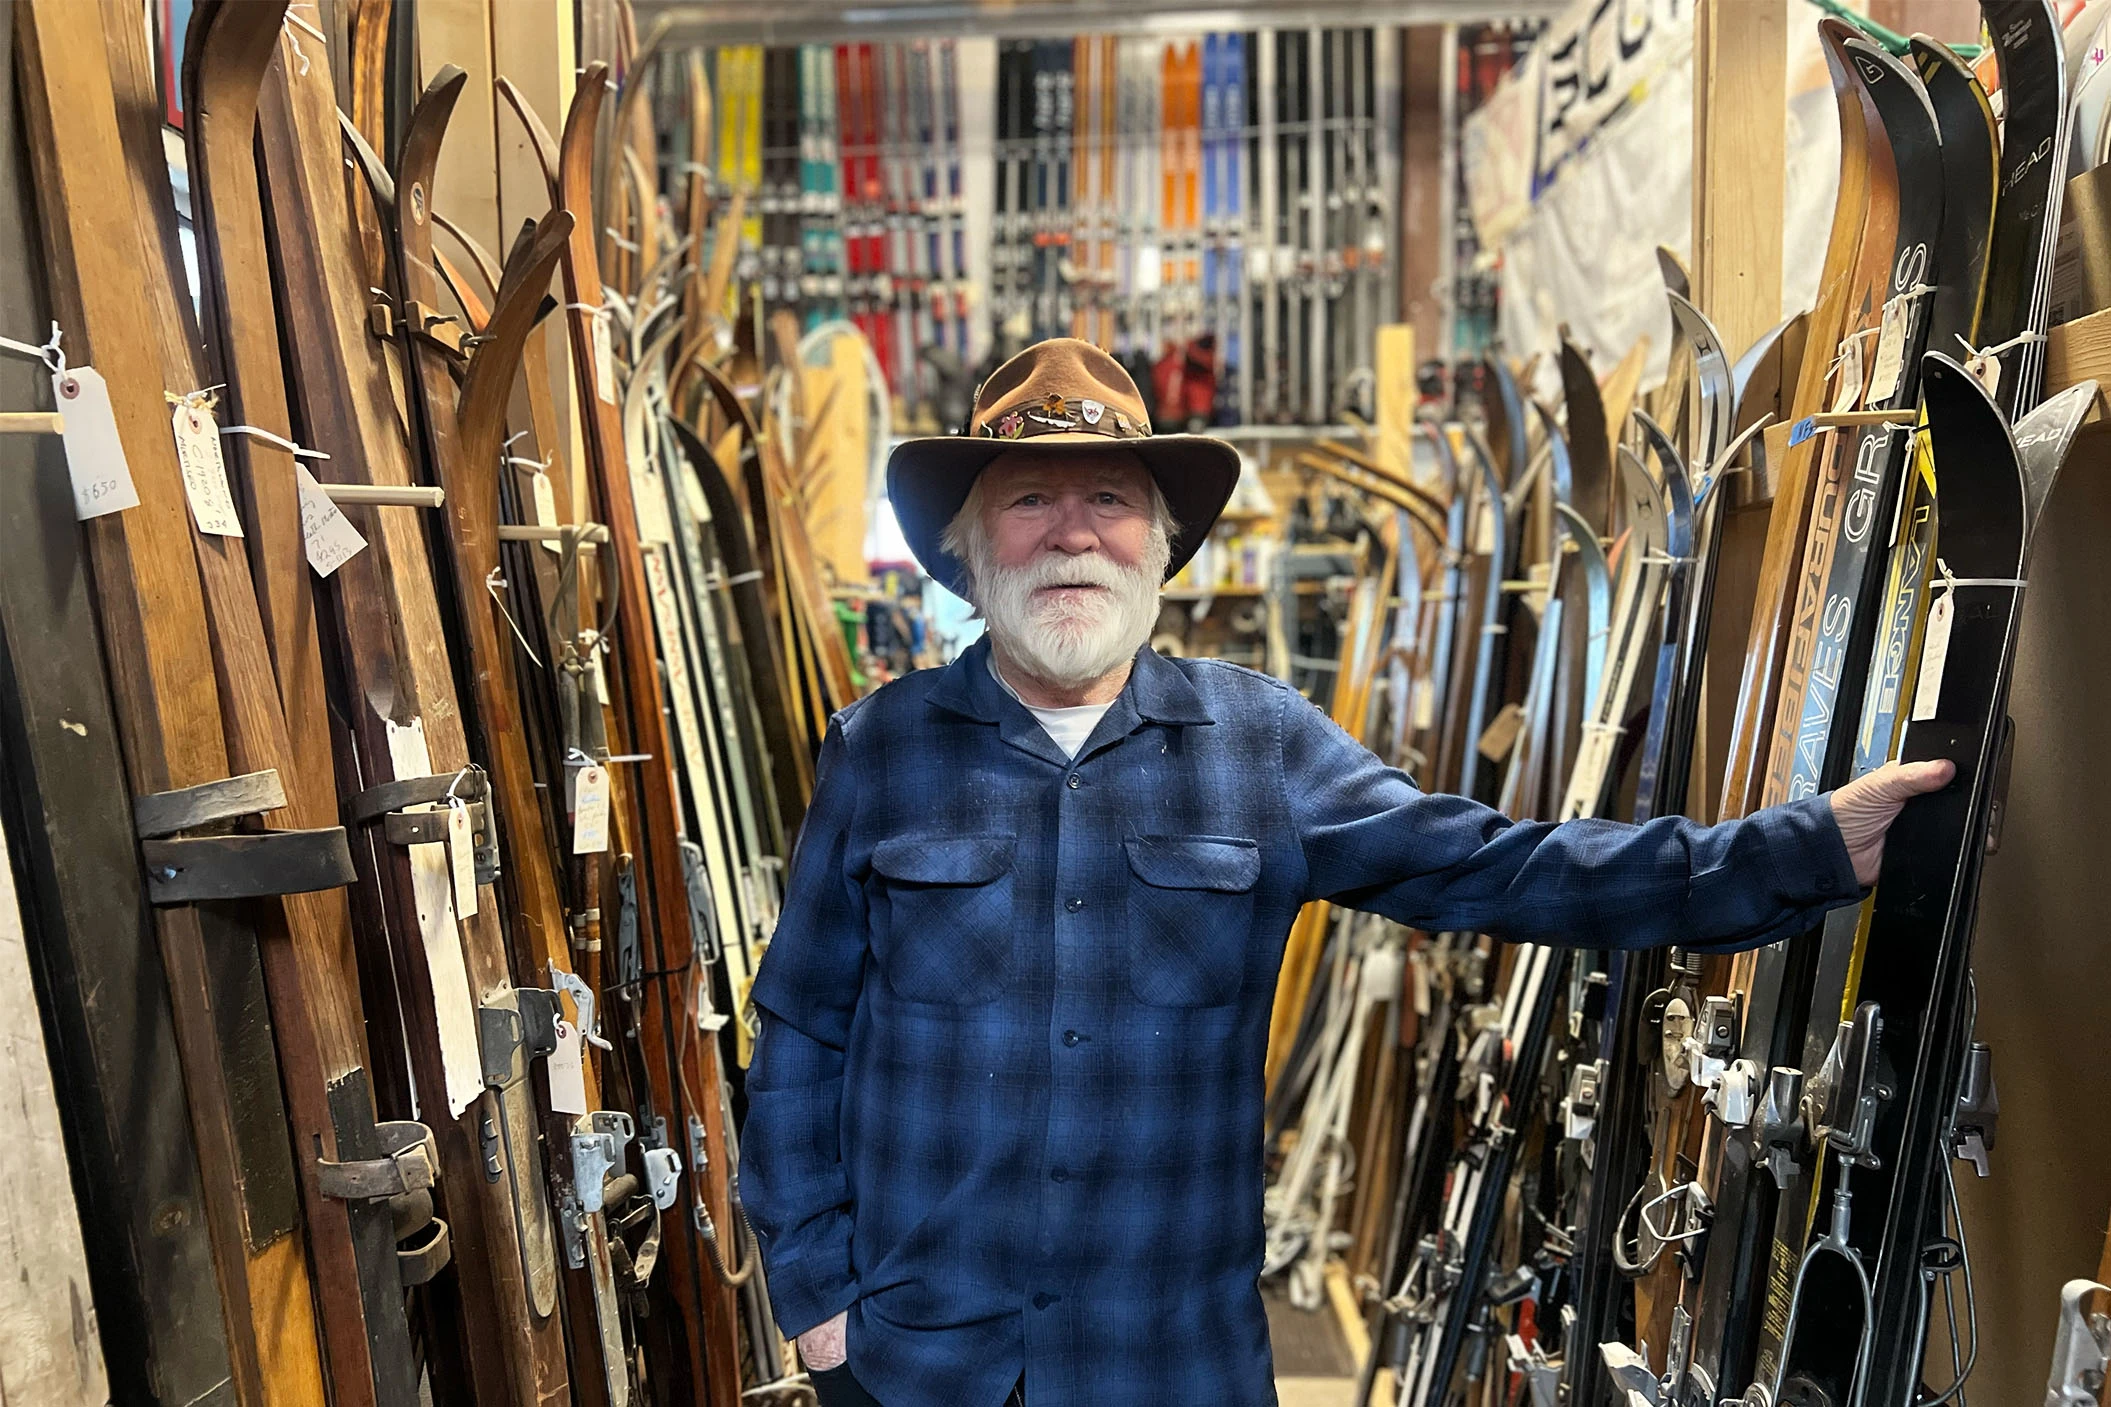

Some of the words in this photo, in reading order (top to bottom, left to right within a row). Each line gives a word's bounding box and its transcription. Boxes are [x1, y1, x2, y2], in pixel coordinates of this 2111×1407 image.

[2001, 136, 2052, 197] HEAD
[80, 479, 117, 505] $650
[1878, 505, 1930, 714] LANGE
